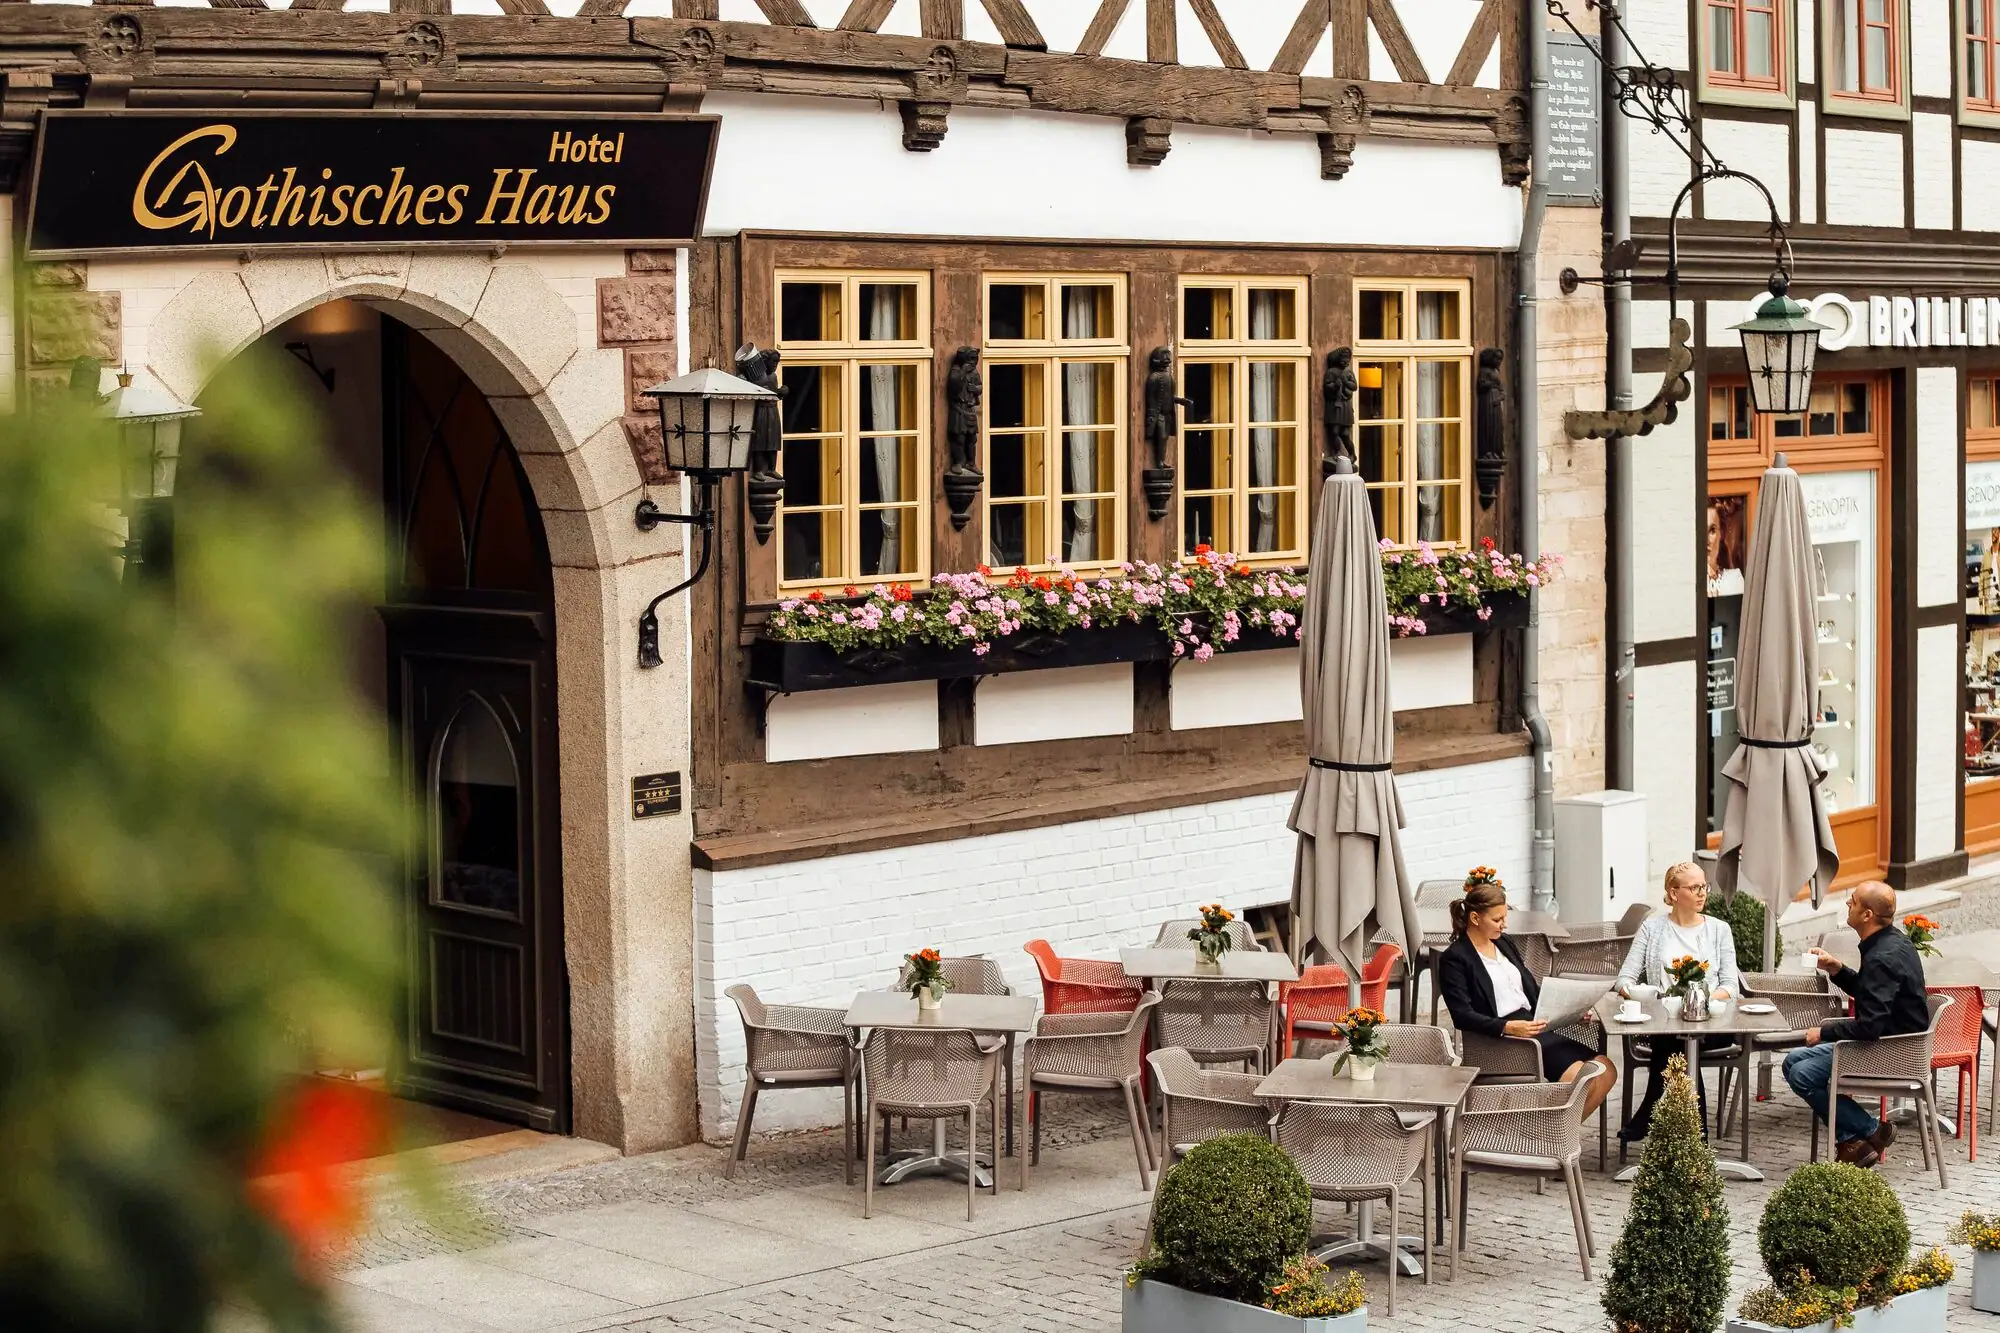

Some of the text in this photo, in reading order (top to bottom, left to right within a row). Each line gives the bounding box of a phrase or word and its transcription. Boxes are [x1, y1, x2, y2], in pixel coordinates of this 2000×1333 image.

[548, 131, 625, 163] Hotel
[132, 124, 615, 240] Gothisches Haus
[1807, 496, 1859, 518] GENOPTIK
